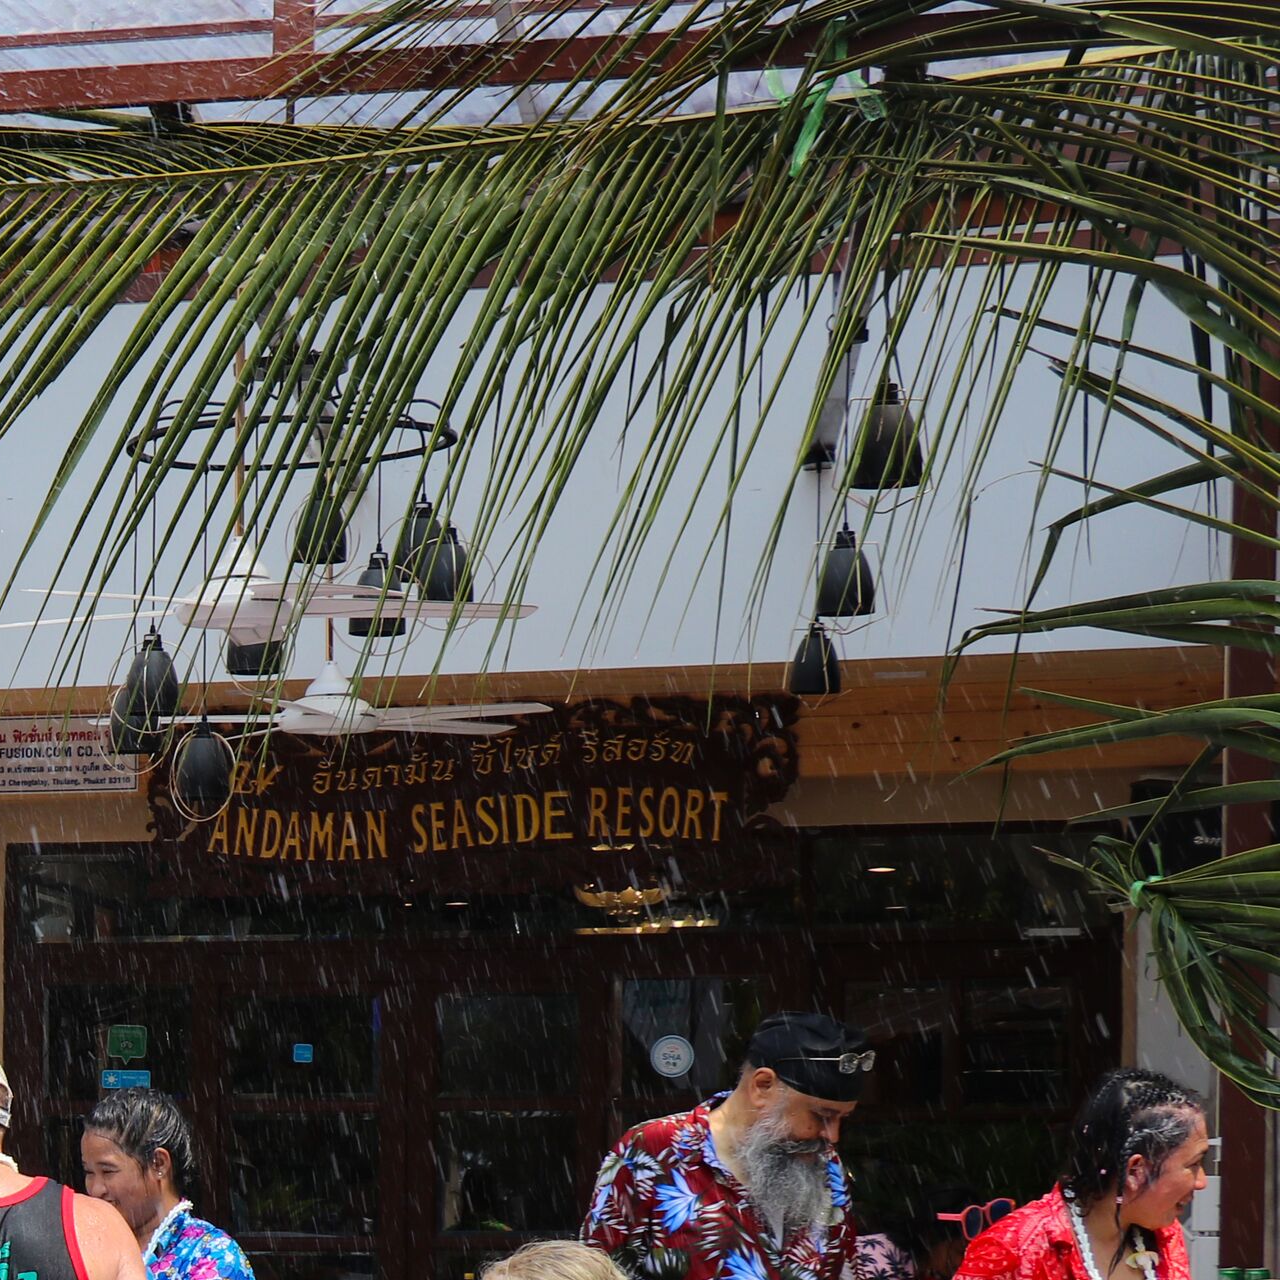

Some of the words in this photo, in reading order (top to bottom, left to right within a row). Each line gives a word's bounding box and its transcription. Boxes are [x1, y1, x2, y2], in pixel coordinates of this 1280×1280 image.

[207, 804, 388, 861] ANDAMAN
[411, 790, 574, 854] SEASIDE
[588, 785, 728, 842] RESORT
